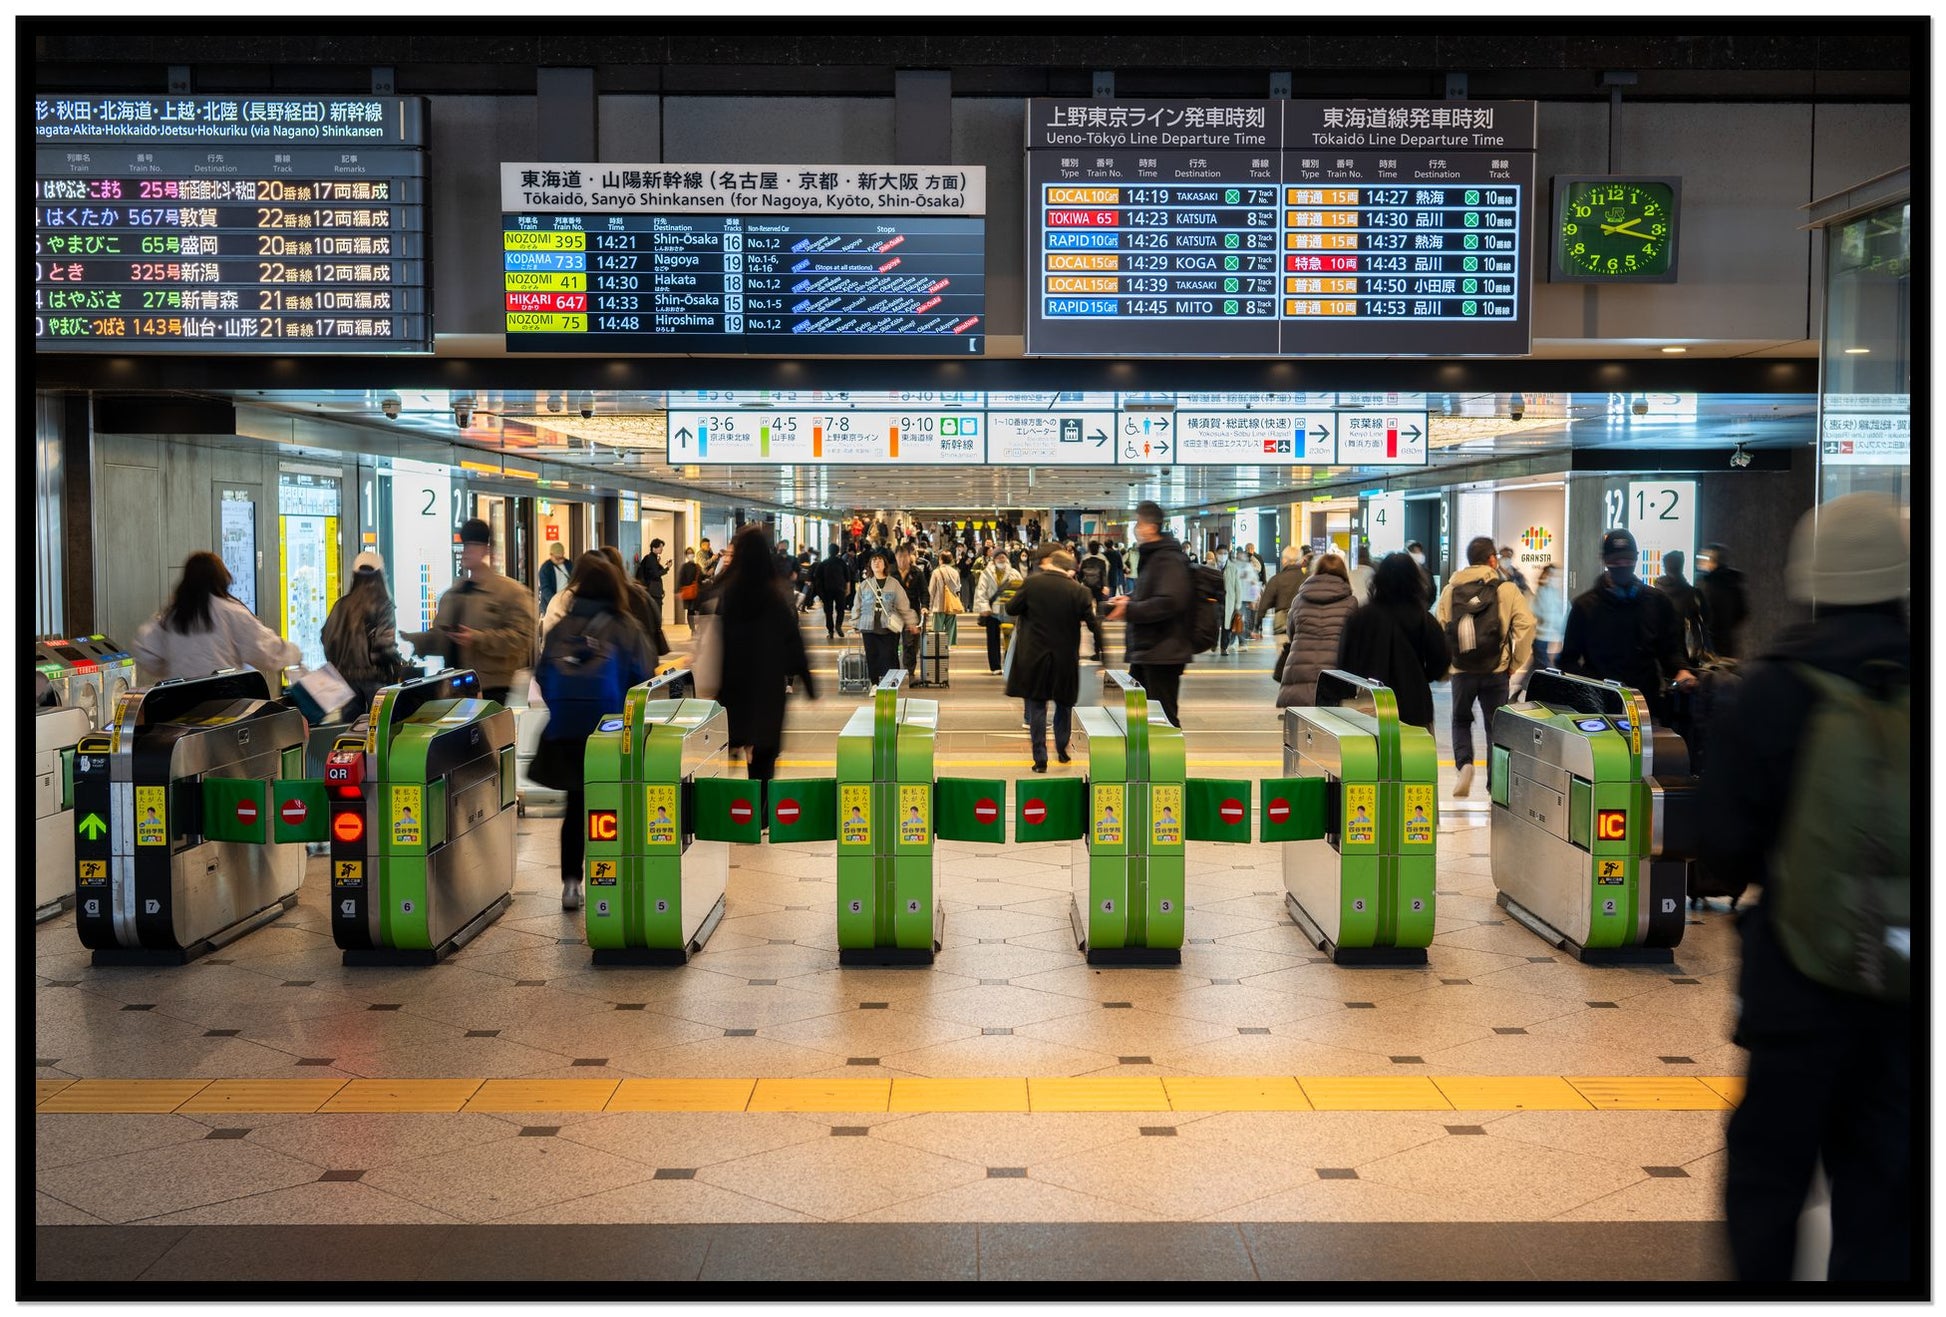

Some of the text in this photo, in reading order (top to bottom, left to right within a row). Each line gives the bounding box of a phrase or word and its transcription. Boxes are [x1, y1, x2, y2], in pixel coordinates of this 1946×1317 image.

[1047, 106, 1266, 128] 上野東京ライン発車時刻
[1323, 108, 1494, 130] 東海道線発車時刻
[251, 125, 270, 138] (via
[274, 125, 319, 139] Nagano)
[322, 126, 383, 137] Shinkansen
[1046, 132, 1266, 147] Ueno-Tōkyō Line Departure Time
[1312, 133, 1504, 148] Tōkaidō Line Departure Time
[70, 164, 89, 172] Train
[130, 164, 148, 172] Train
[150, 164, 162, 172] No.
[194, 164, 238, 172] Destination
[1061, 170, 1080, 178] Type
[1175, 170, 1220, 178] Destination
[1250, 170, 1270, 178] Track
[140, 181, 178, 199] 25号
[258, 180, 311, 200] 20番線
[313, 182, 388, 200] 17両編成
[1608, 189, 1624, 200] 12
[524, 191, 964, 210] Tōkaidō, Sanyō Shinkansen (for Nagoya, Kyōto, Shin-Ōsaka)
[1049, 190, 1090, 202] LOCAL
[1128, 190, 1168, 203] 14:19
[1177, 192, 1218, 200] TAKASAKI
[1248, 190, 1256, 204] 7
[1297, 190, 1322, 204] 普通
[1367, 190, 1408, 204] 14:27
[1416, 190, 1444, 205] 熱海
[1591, 194, 1605, 206] 11
[1630, 193, 1638, 204] 1
[1575, 206, 1592, 218] 10
[1644, 204, 1655, 216] 2
[46, 208, 119, 226] はくたか
[129, 209, 179, 226] 567号
[180, 208, 218, 227] 敦賀
[258, 208, 312, 228] 22番線
[314, 210, 389, 227] 12両編成
[1050, 212, 1256, 226] TOKIWA 65 14:23 KATSUTA 8
[876, 226, 896, 234] Stops
[1566, 224, 1578, 236] 9
[1651, 224, 1662, 236] 3
[506, 232, 740, 248] NOZOMI 395 14:21 Shin-Ōsaka 16
[1050, 235, 1089, 246] RAPID
[1127, 234, 1168, 248] 14:26
[1176, 236, 1217, 246] KATSUTA
[1247, 234, 1256, 248] 8
[1574, 242, 1585, 254] 8
[1642, 243, 1653, 254] 4
[507, 254, 740, 269] KODAMA 733 14:27 Nagoya 19
[1295, 256, 1322, 270] 特急
[1366, 257, 1407, 270] 14:43
[1415, 256, 1442, 271] 品川
[1590, 254, 1600, 266] 7
[1608, 258, 1618, 270] 6
[1625, 254, 1636, 266] 5
[50, 262, 84, 281] とき
[130, 264, 181, 281] 325号
[181, 262, 220, 282] 新潟
[508, 274, 740, 290] NOZOMI 41 14:30 Hakata 18
[510, 294, 741, 310] HIKARI 647 14:33 Shin-Ōsaka 15
[509, 314, 741, 330] NOZOMI 75 14:48 Hiroshima 19
[1350, 418, 1383, 428] 京葉線
[772, 434, 795, 442] 山手線
[825, 434, 878, 442] 上野東京ライン
[1016, 428, 1056, 436] エレベーター
[940, 440, 974, 450] 新幹線
[422, 490, 436, 516] 2
[1376, 508, 1387, 526] 4
[1521, 554, 1552, 562] GRANSTA
[329, 768, 347, 780] QR
[592, 816, 616, 838] IC
[1600, 815, 1624, 838] IC
[90, 902, 96, 910] 8
[148, 902, 154, 910] 7
[346, 902, 352, 910] 7
[404, 902, 410, 912] 6
[600, 902, 606, 912] 6
[658, 902, 664, 910] 5
[852, 902, 859, 910] 5
[910, 902, 916, 910] 4
[1104, 902, 1111, 910] 4
[1162, 902, 1169, 910] 3
[1356, 901, 1363, 910] 3
[1414, 901, 1420, 910] 2
[1606, 902, 1613, 910] 2
[1666, 902, 1671, 910] 1
